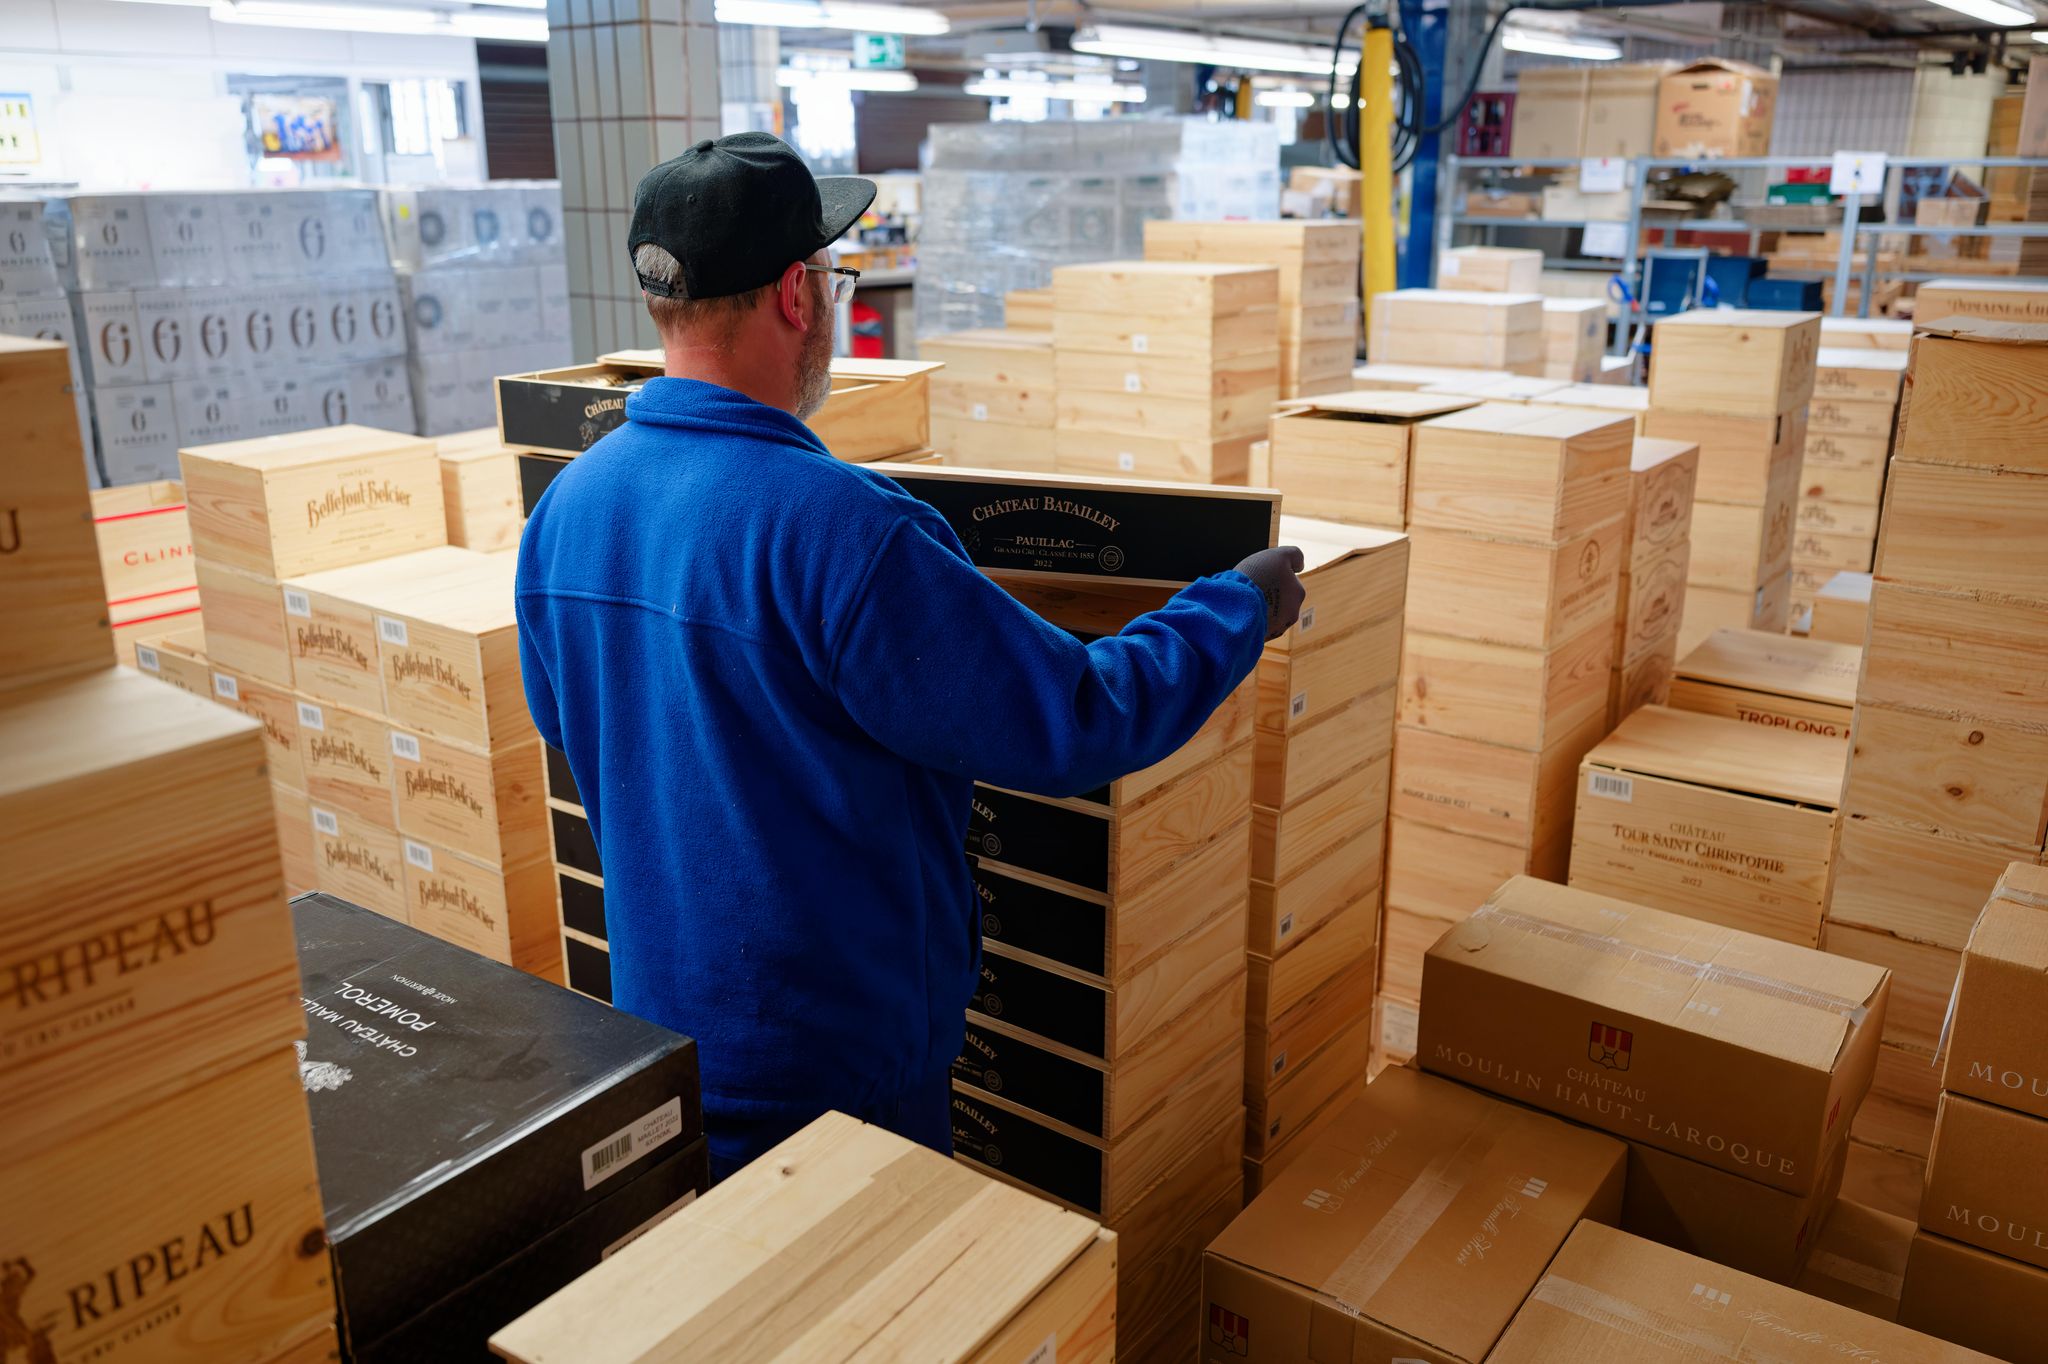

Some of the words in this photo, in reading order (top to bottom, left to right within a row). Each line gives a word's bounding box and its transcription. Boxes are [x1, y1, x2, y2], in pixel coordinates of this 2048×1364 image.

[584, 398, 624, 419] CHÂTEAU
[972, 497, 1040, 522] CHÂTEAU
[1043, 496, 1121, 533] BATAILLEY
[1016, 536, 1075, 549] PAUILLAC
[1080, 552, 1095, 560] 1855
[1033, 559, 1053, 568] 2022
[1736, 708, 1837, 738] TROPLONG
[1612, 823, 1650, 845] TOUR
[1652, 832, 1692, 853] SAINT
[1695, 841, 1785, 875] CHRISTOPHE
[1669, 822, 1726, 841] CHÂTEAU
[12, 899, 216, 1010] RIPEAU
[299, 997, 345, 1024] MAILL
[333, 981, 437, 1032] POMEROL
[337, 1019, 418, 1058] CHÂTEAU
[1566, 1065, 1647, 1104] CHÂTEAU
[1968, 1061, 2048, 1097] MOU
[1434, 1043, 1542, 1091] MOULIN
[1555, 1083, 1795, 1177] HAUT-LAROQUE
[1945, 1205, 2048, 1250] MOUL
[66, 1200, 255, 1331] RIPEAU
